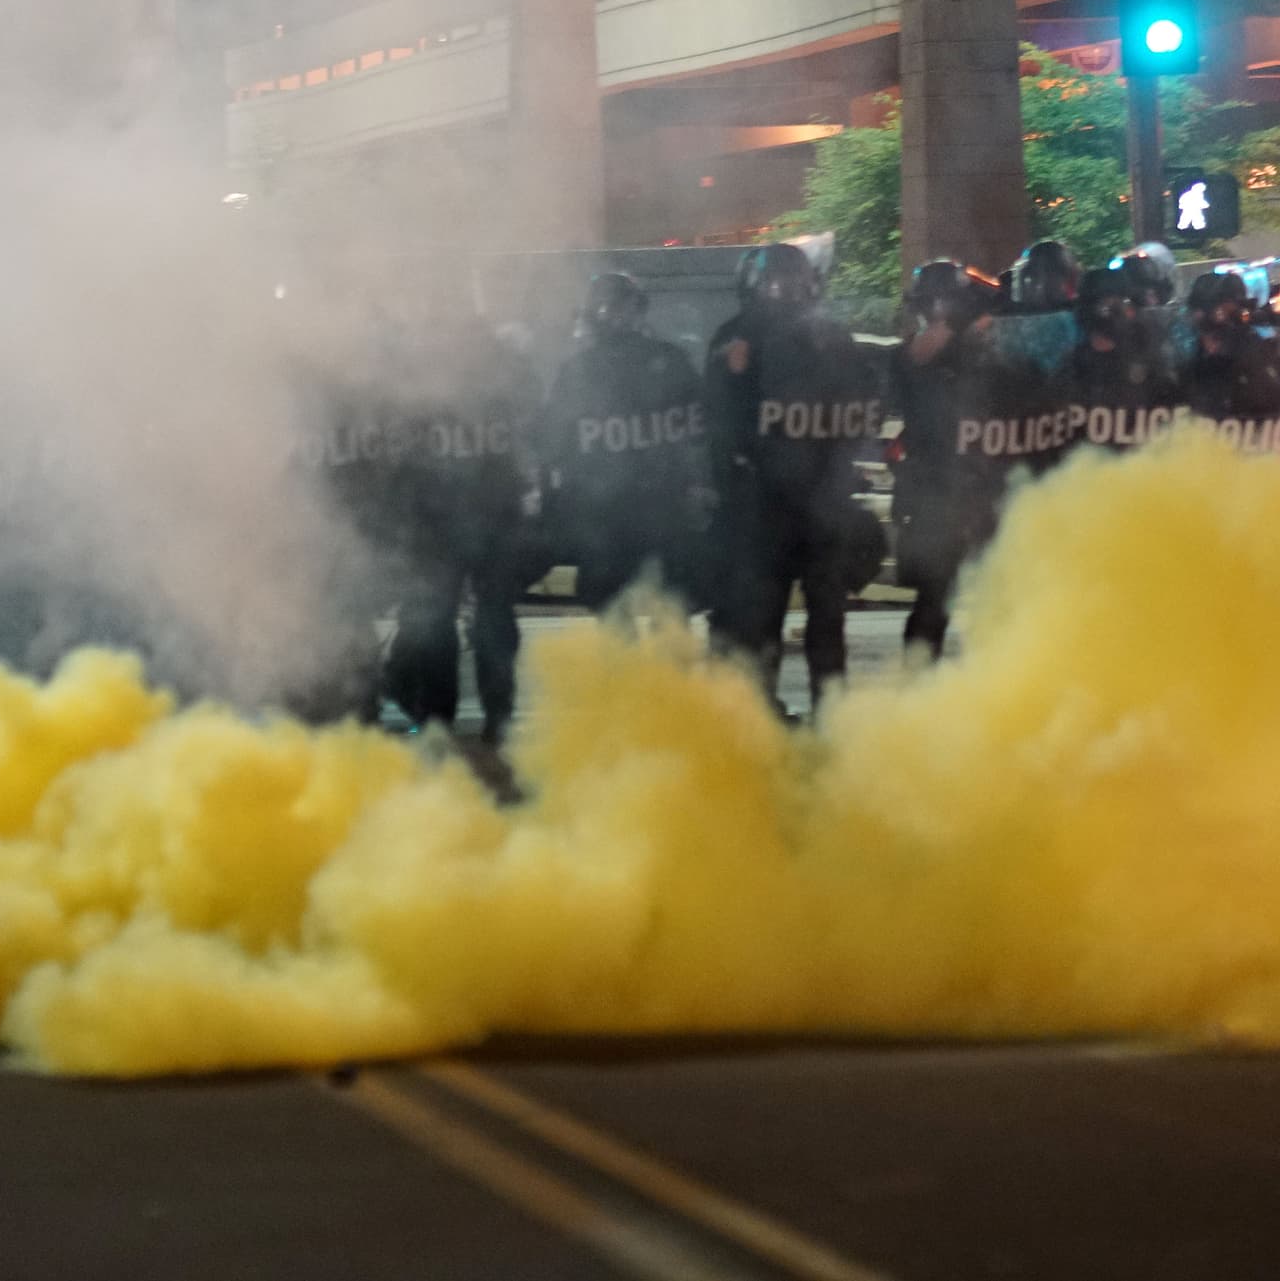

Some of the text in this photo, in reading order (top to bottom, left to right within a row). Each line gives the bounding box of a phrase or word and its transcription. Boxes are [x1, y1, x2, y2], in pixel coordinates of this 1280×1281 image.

[577, 403, 704, 455] POLICE
[757, 399, 881, 440] POLICE
[955, 408, 1066, 457] POLICE
